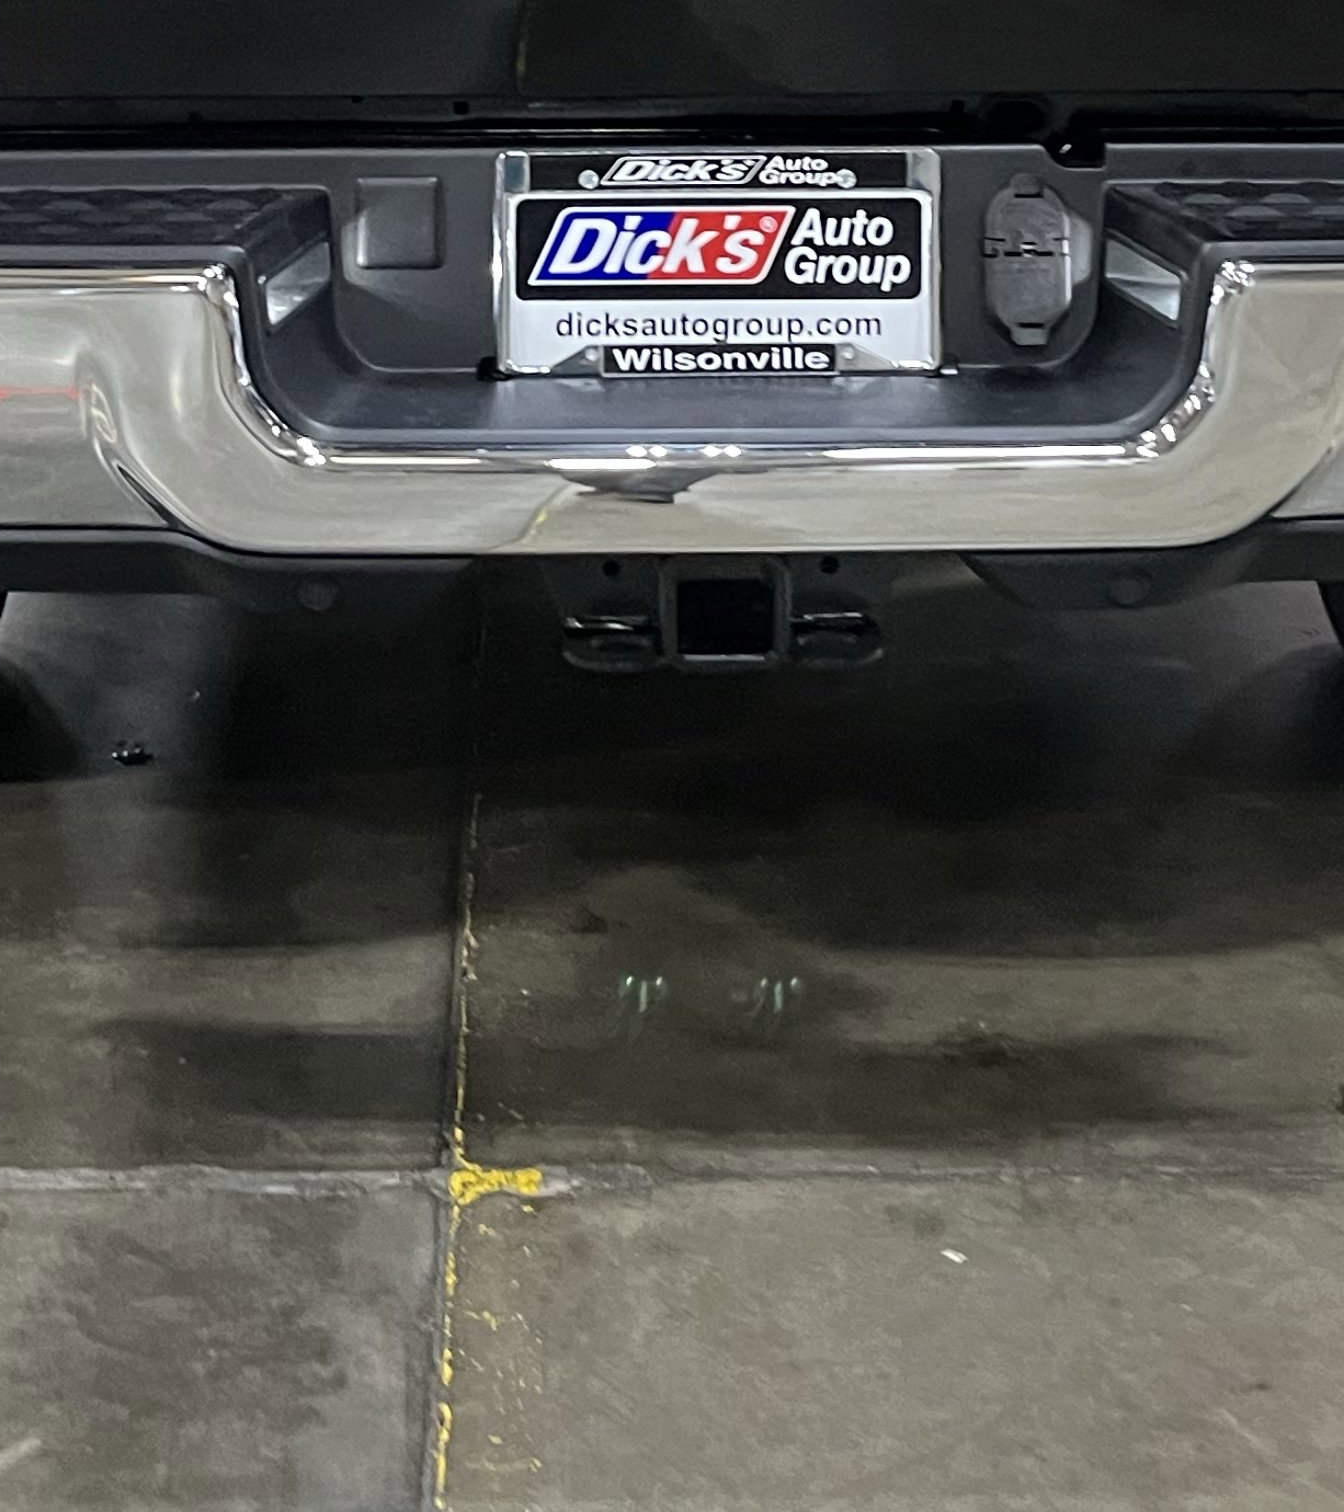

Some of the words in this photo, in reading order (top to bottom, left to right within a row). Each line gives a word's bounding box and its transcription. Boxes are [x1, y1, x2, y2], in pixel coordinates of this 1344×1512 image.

[612, 158, 750, 181] Dick's
[764, 155, 829, 171] Auto
[759, 169, 839, 187] Group
[548, 215, 764, 275] Dick's
[791, 208, 894, 248] Auto
[784, 250, 912, 292] Group
[556, 311, 882, 342] dicksautogroup.com
[612, 346, 831, 373] Wilsonville
